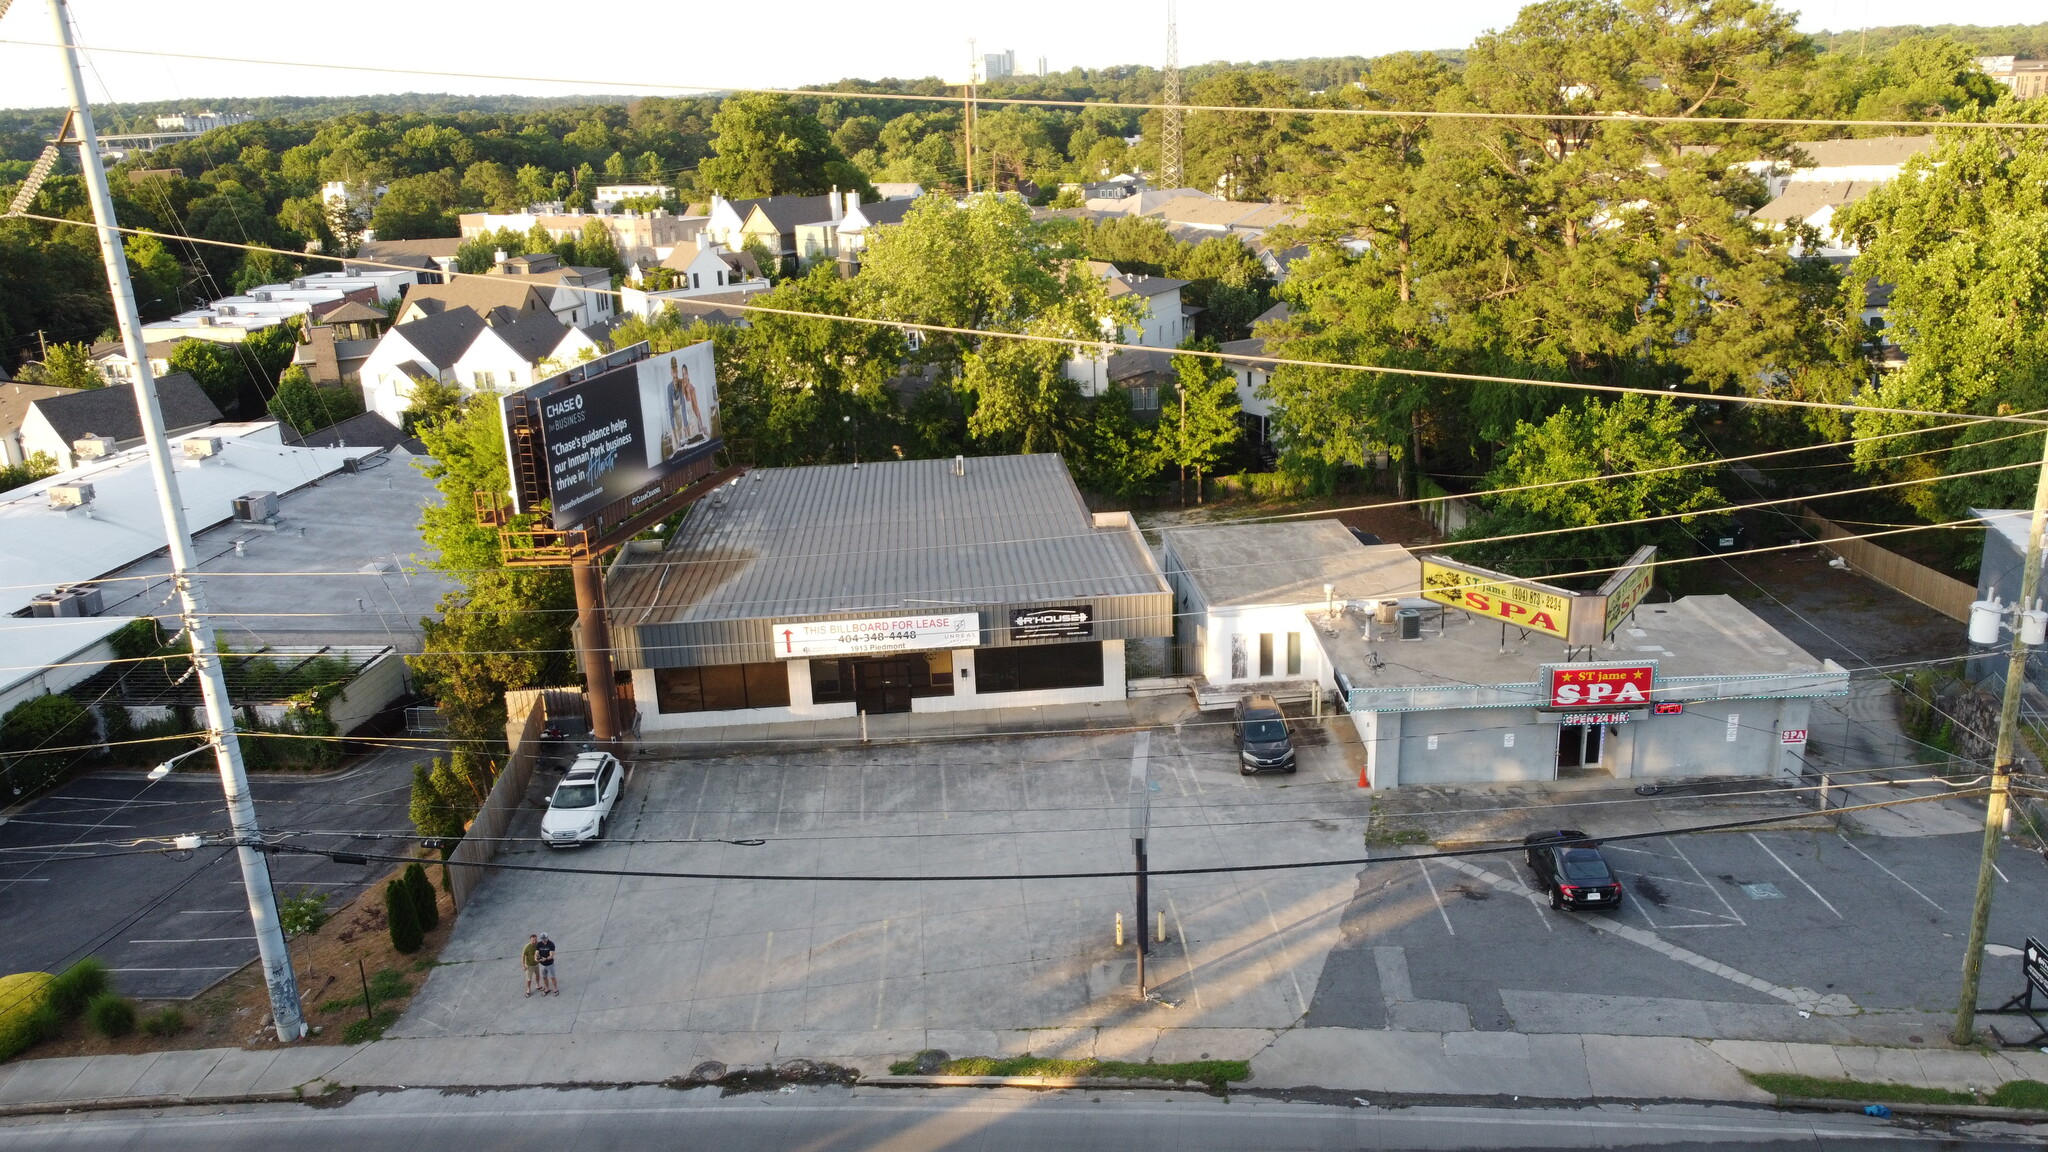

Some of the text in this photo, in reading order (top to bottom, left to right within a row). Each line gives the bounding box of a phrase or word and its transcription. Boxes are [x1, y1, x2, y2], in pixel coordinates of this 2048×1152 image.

[547, 398, 575, 418] CHASE
[555, 411, 586, 431] BUSINESS
[582, 428, 610, 449] guidance
[610, 418, 628, 434] helps
[554, 433, 632, 474] our Inman Park business
[556, 472, 578, 491] thrive
[578, 470, 586, 482] in
[559, 486, 604, 512] chaseforbusiness.com
[1464, 576, 1480, 589] ST
[1511, 586, 1528, 602] (404)
[1621, 575, 1650, 616] SPA
[1465, 592, 1560, 632] SPA
[803, 618, 950, 636] THIS BILLBOARD FOR LEASE
[838, 630, 917, 644] 404-348-4448
[944, 632, 977, 640] UNREAL
[869, 642, 906, 652] Piedmont
[1578, 671, 1627, 683] ST jame
[1556, 682, 1645, 704] SPA
[1565, 711, 1627, 724] OPEN 24 HR
[1656, 703, 1682, 713] OPEN
[1783, 731, 1804, 740] SPA
